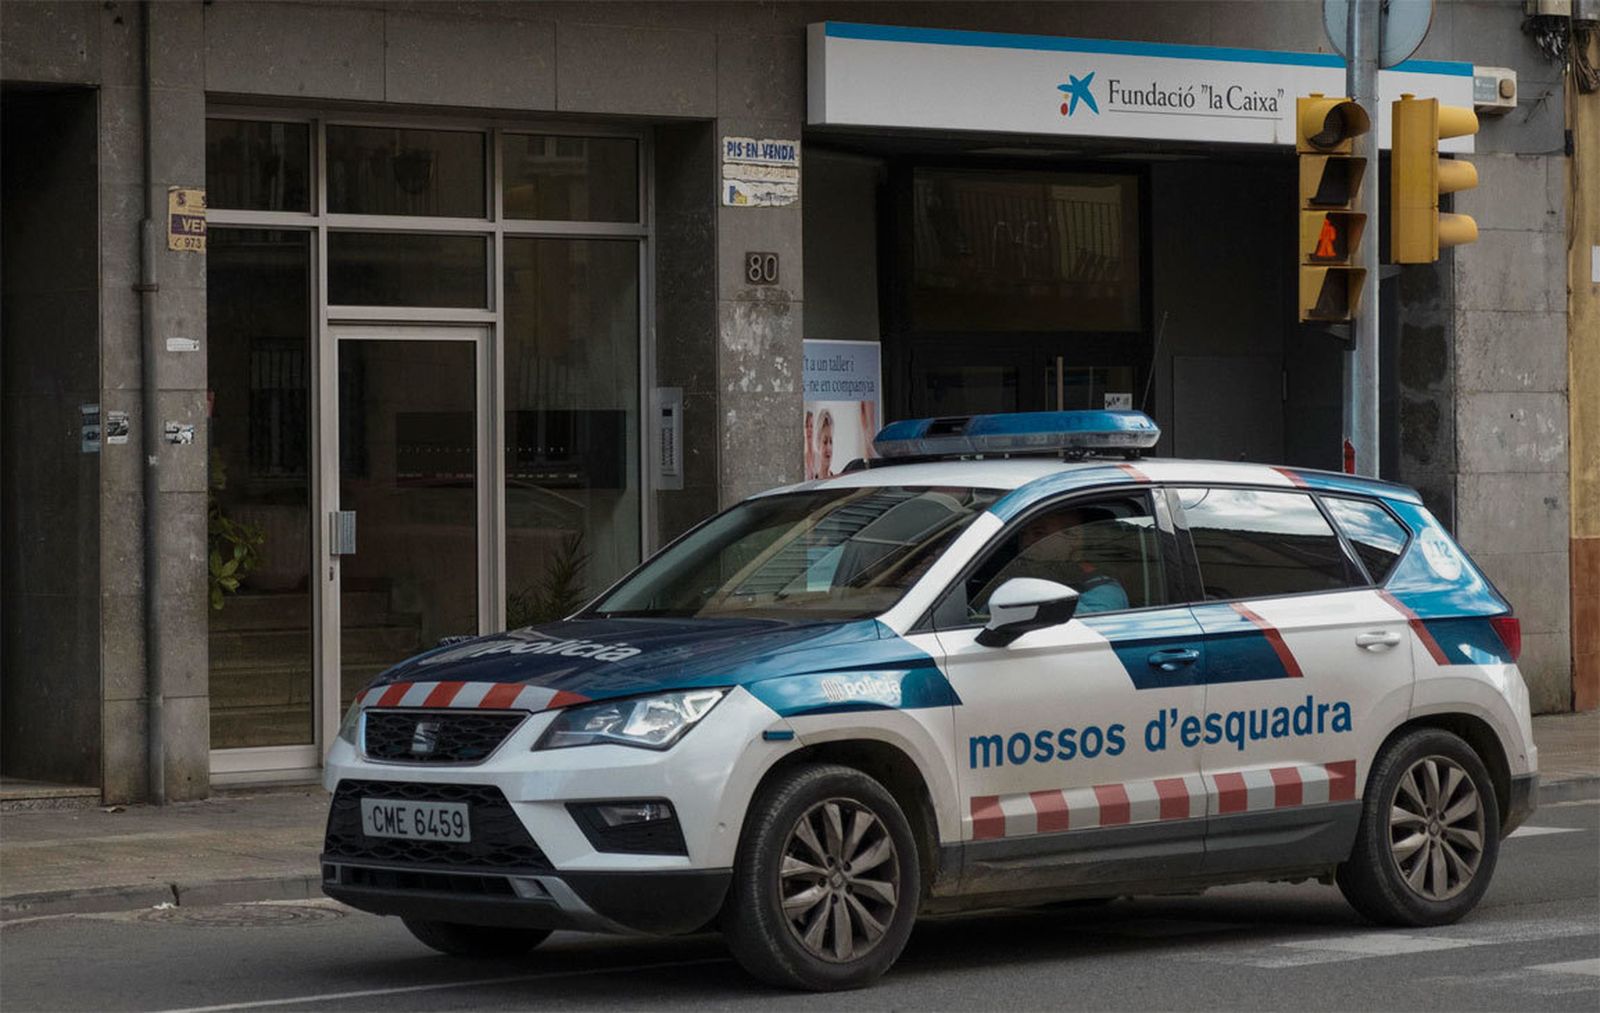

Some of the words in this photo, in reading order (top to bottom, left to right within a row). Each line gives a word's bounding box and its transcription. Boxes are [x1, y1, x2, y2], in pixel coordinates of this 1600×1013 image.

[1108, 79, 1196, 109] Fundació
[727, 141, 742, 157] PIS
[745, 142, 759, 158] EN
[762, 143, 795, 161] VENDA
[749, 254, 778, 282] 80
[829, 355, 849, 372] taller
[969, 722, 1126, 769] mossos
[1144, 695, 1353, 751] d'esquadra
[372, 805, 409, 835] CME
[414, 808, 465, 838] 6459
